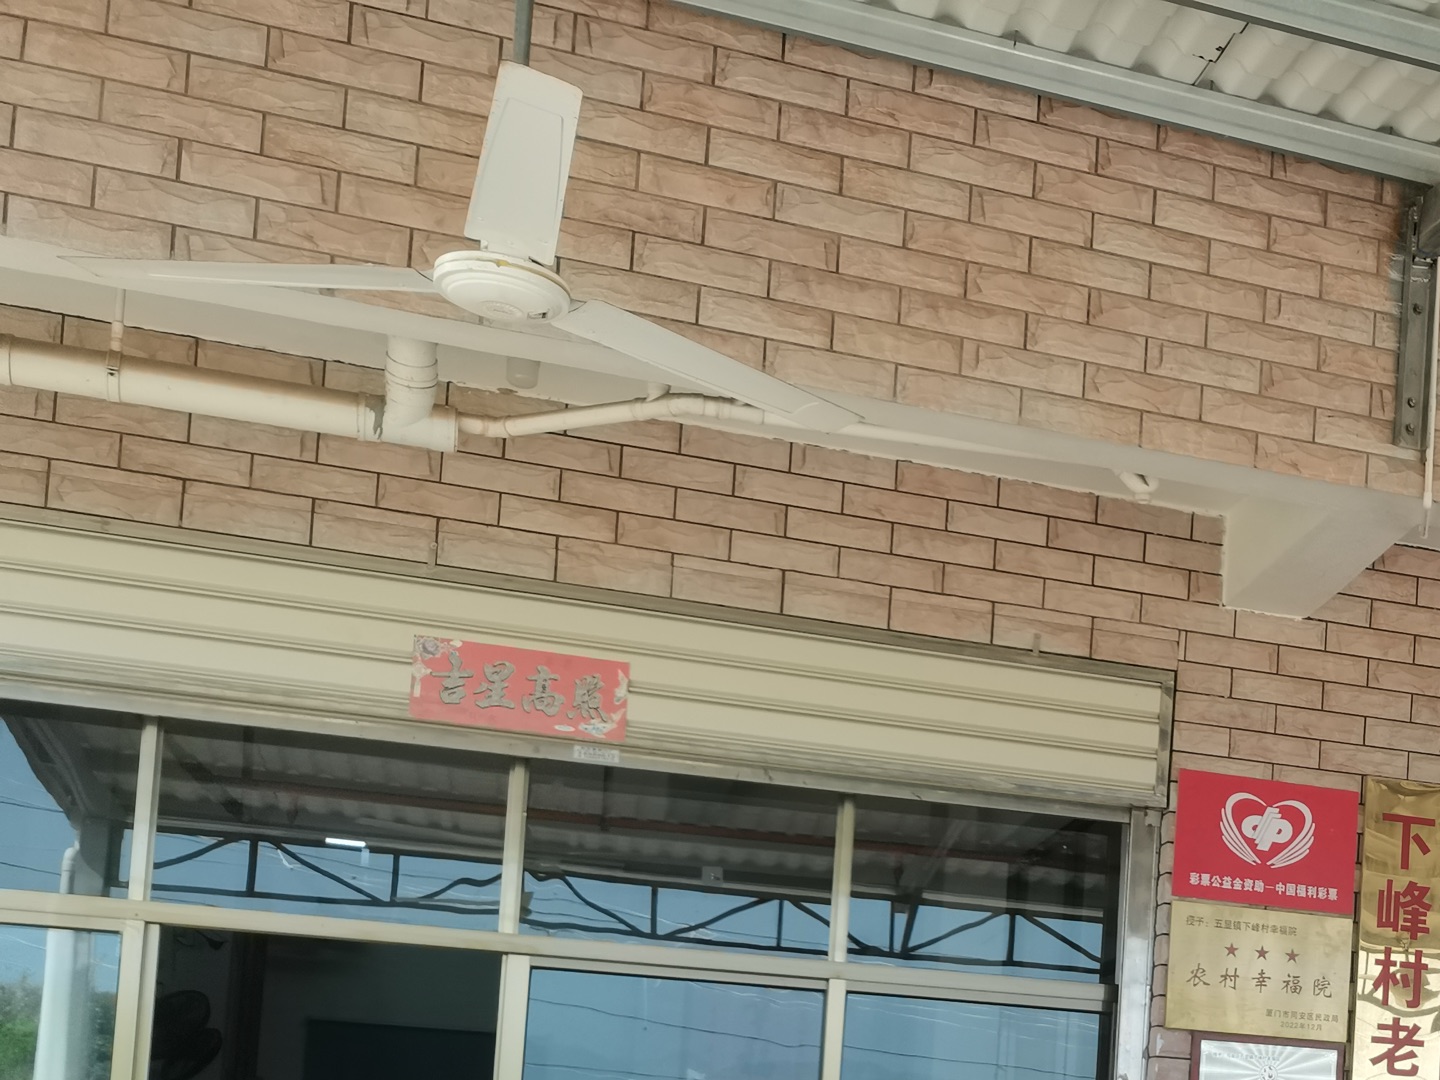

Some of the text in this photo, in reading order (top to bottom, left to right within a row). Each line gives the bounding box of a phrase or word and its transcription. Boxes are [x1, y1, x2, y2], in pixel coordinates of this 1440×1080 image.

[430, 652, 608, 722] 吉星高照
[1186, 963, 1333, 998] 农村幸福院
[1280, 1021, 1322, 1032] 2022年12月
